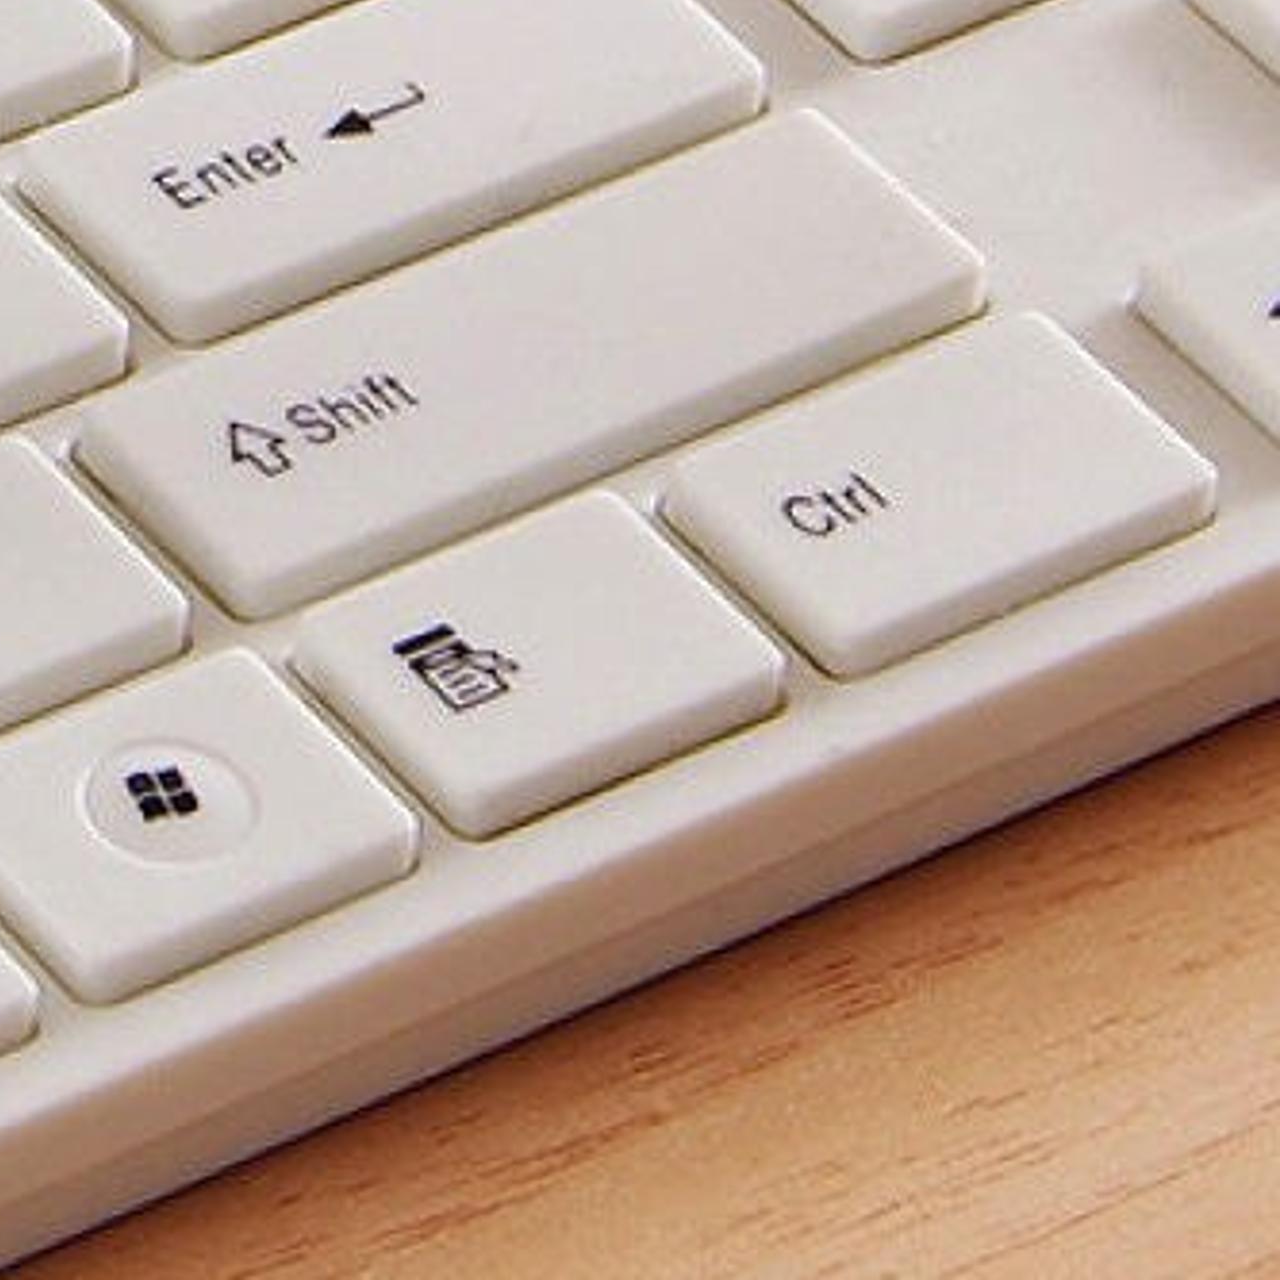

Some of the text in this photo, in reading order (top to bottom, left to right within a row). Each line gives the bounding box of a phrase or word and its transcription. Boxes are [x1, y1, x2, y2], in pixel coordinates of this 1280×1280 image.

[151, 137, 298, 210] Enter
[285, 374, 420, 445] Shift
[780, 472, 888, 539] Ctrl
